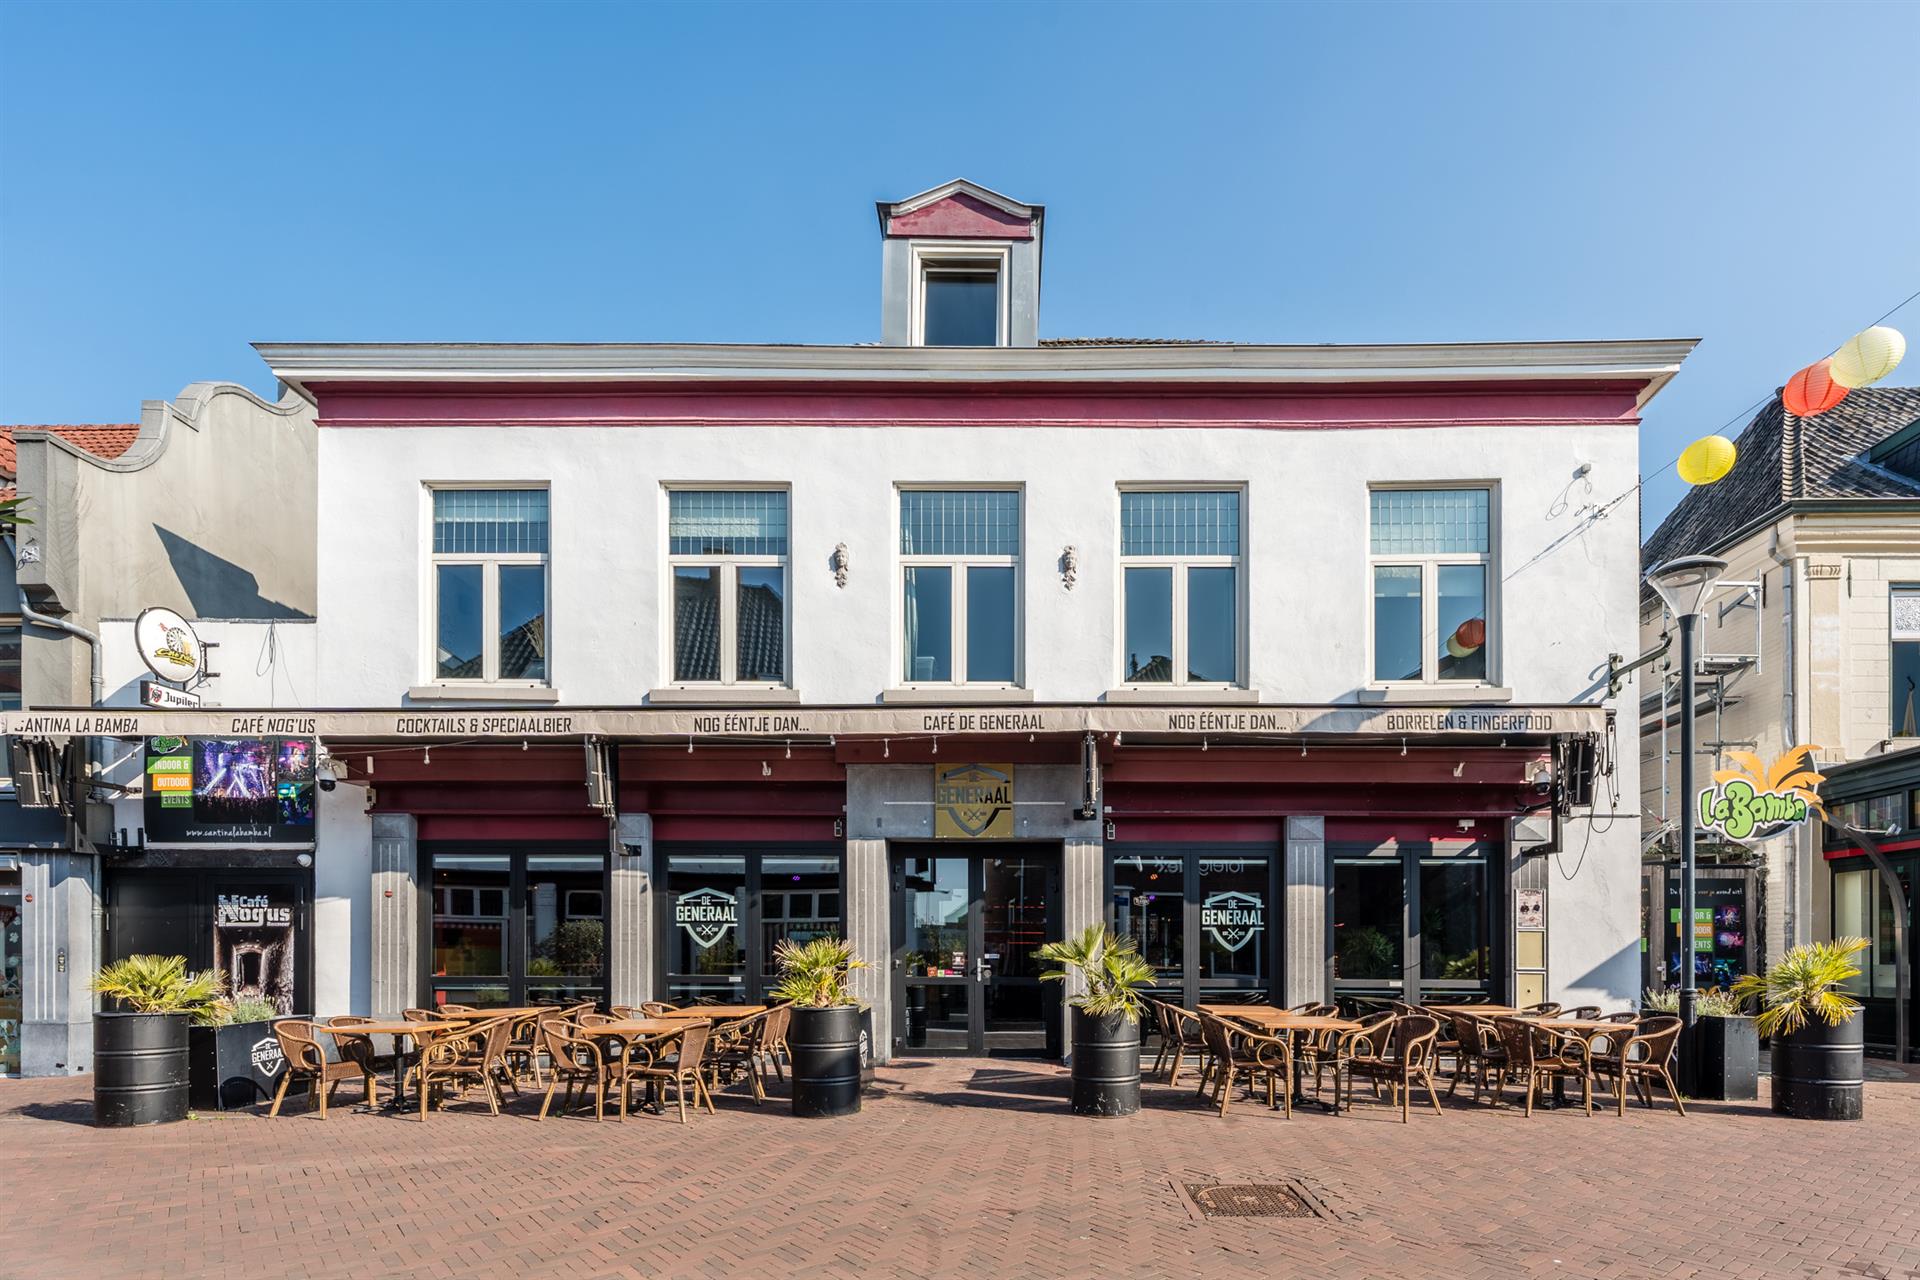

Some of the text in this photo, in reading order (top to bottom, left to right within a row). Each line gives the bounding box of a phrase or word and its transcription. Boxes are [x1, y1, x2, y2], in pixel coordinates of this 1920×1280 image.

[164, 692, 198, 709] Jupiler
[76, 718, 90, 733] LA
[95, 718, 138, 733] BAMBA
[231, 716, 316, 733] CAFÉ NOG'US
[397, 718, 571, 733] COCKTAILS & SPECIAALBIER
[694, 714, 809, 732] NOG ÉÉNTJE DAN...
[923, 712, 1045, 731] CAFÉ DE GENERAAL
[1169, 712, 1287, 730] NOG ÉÉNTJE DAN...
[1387, 715, 1552, 731] BORRELEN & FINGERFOOD
[154, 760, 182, 770] INDOOR
[157, 777, 190, 787] OUTDOOR
[163, 795, 190, 804] EVENTS
[937, 786, 1012, 804] GENERAAL
[1701, 781, 1806, 839] La Bamba
[240, 895, 268, 907] Café
[701, 896, 711, 905] DE
[1227, 899, 1238, 909] DE
[218, 895, 290, 927] Nog'us
[676, 906, 738, 921] GENERAAL
[1202, 910, 1264, 925] GENERAAL
[251, 1048, 284, 1063] GENERAA
